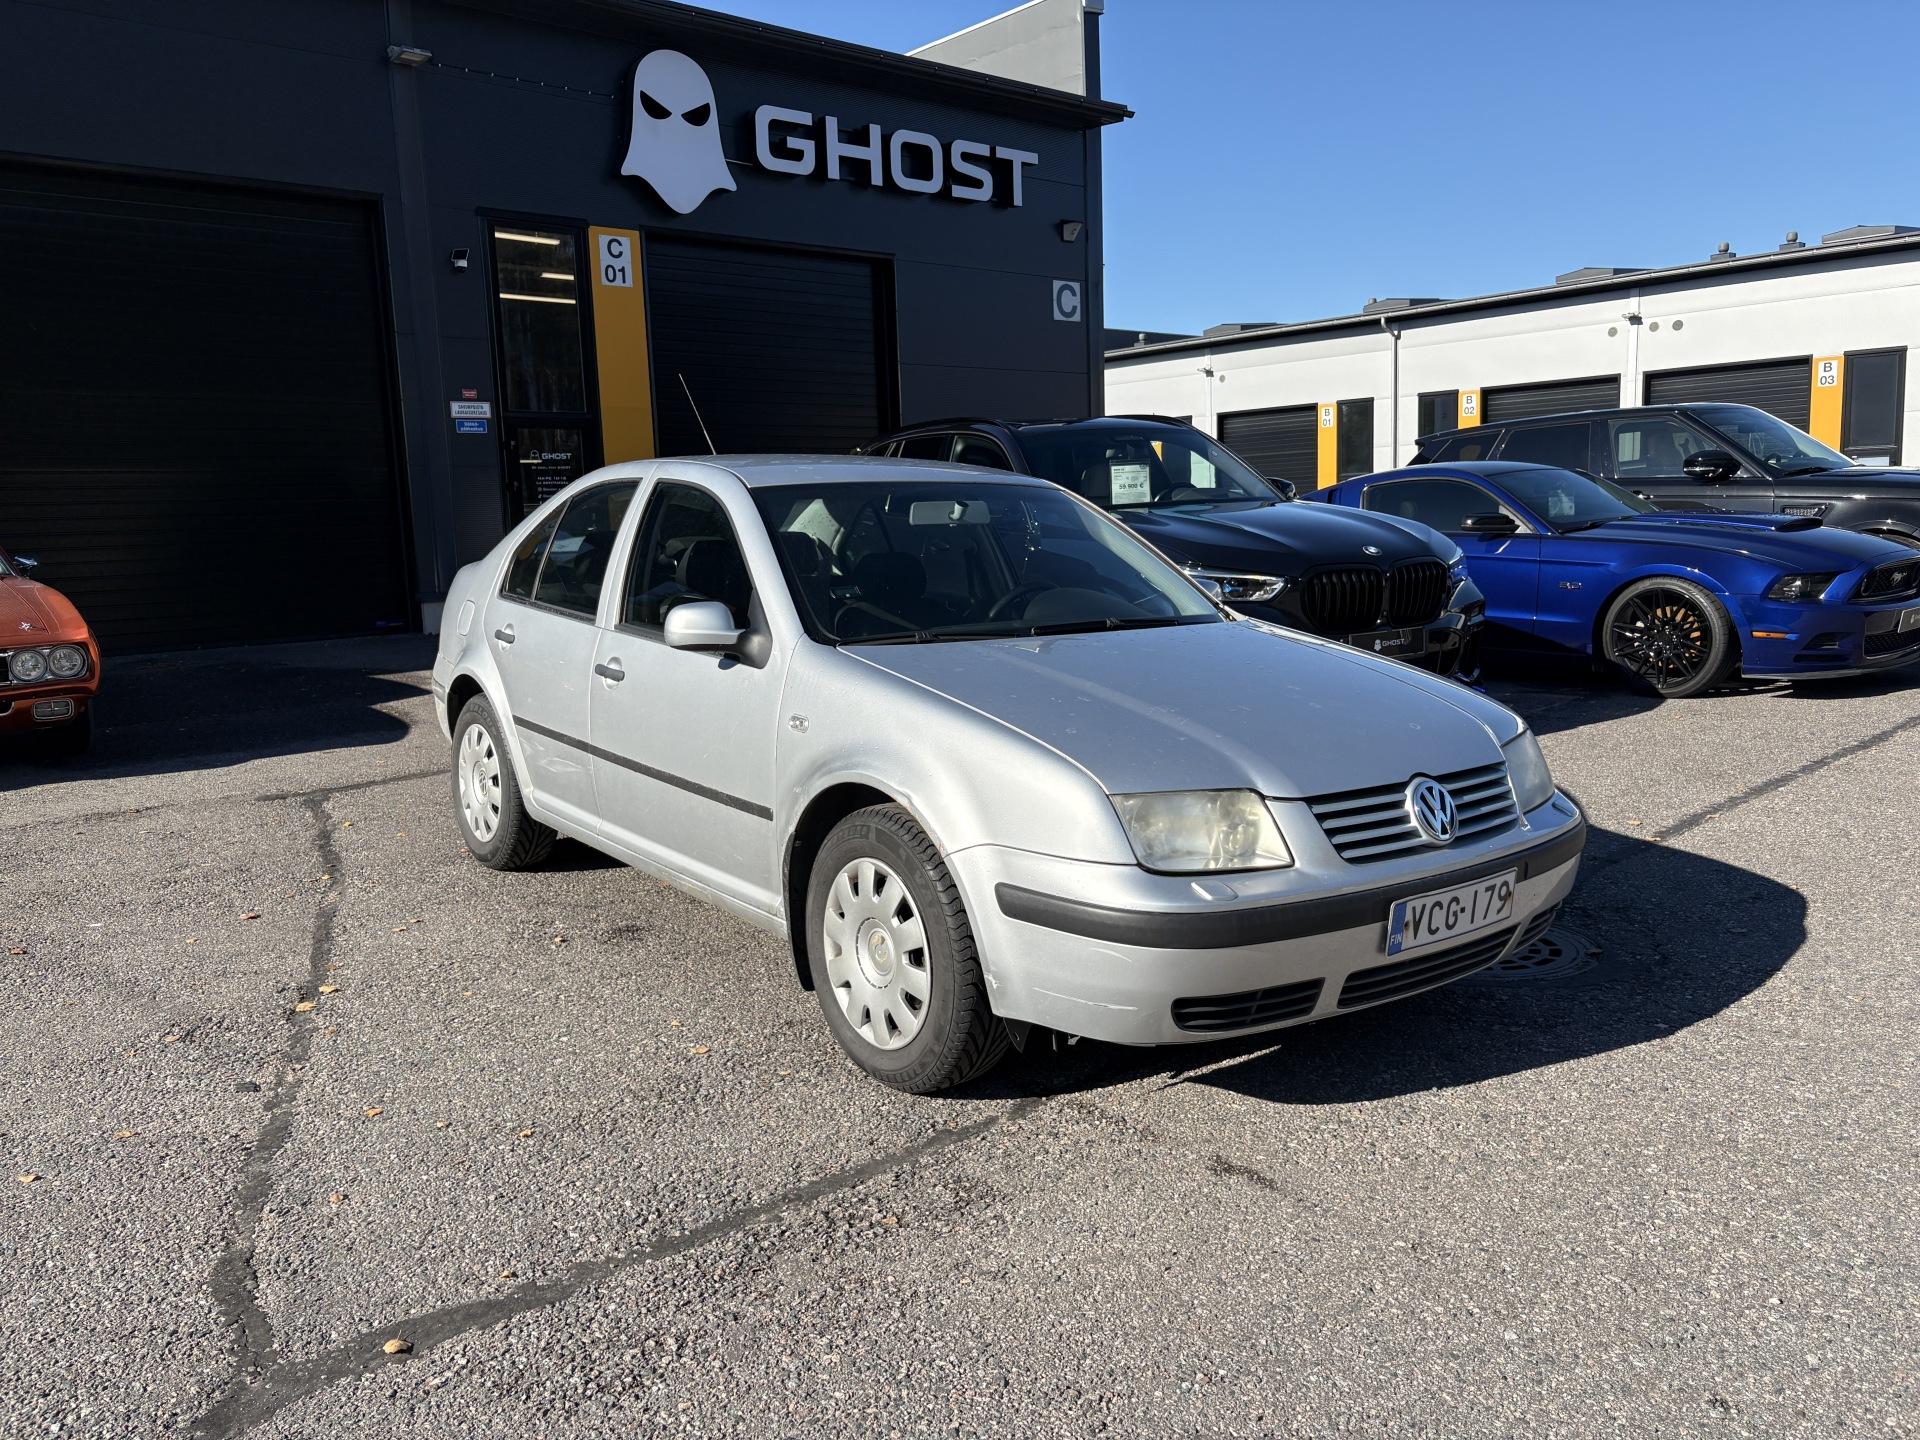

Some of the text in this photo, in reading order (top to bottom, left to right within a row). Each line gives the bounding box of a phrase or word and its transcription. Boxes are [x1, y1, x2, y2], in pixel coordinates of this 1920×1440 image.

[754, 104, 1038, 207] GHOST
[607, 238, 623, 259] C
[605, 264, 626, 284] 01
[1056, 283, 1078, 319] C
[1824, 362, 1832, 373] B
[1820, 375, 1835, 385] 03
[1466, 395, 1473, 404] B
[1324, 408, 1331, 416] B
[1464, 406, 1475, 415] 02
[1322, 418, 1331, 427] 01
[541, 452, 573, 460] GHOST
[1382, 638, 1404, 646] GHOST
[1411, 880, 1510, 940] VCG-179
[1390, 932, 1402, 946] FIN
